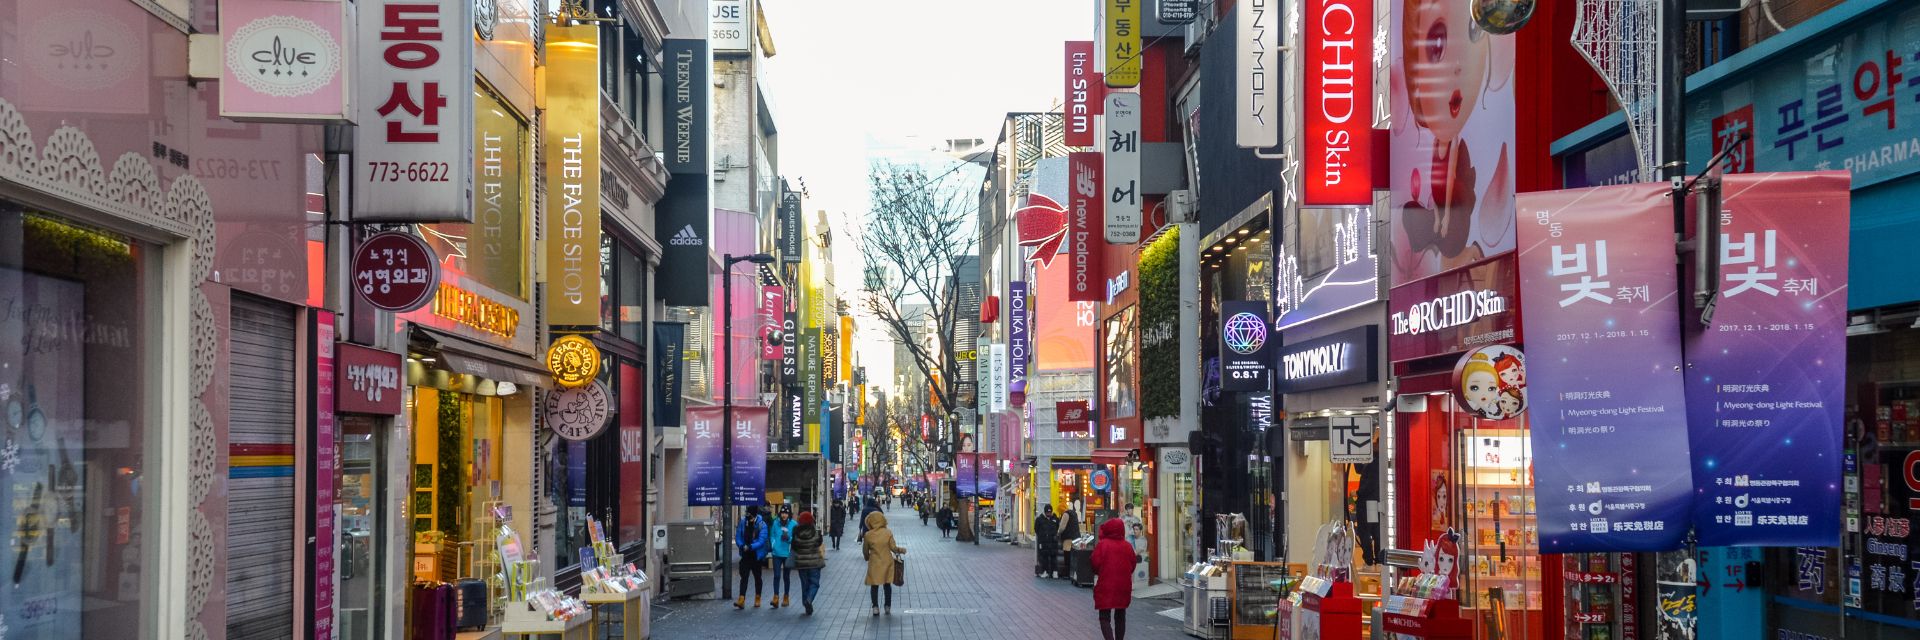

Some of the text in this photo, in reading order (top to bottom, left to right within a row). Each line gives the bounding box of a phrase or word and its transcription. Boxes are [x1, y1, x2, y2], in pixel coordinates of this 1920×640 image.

[677, 50, 692, 163] TEENIE WEENIE
[1073, 52, 1086, 132] the SAEM
[1322, 0, 1354, 187] CHID Skin
[368, 161, 449, 182] 773-6622
[563, 133, 581, 305] THE FACE SHOP
[370, 248, 408, 265] 노정식
[670, 235, 702, 246] adidas
[1076, 199, 1088, 292] new balance
[358, 268, 428, 294] 성형외과
[1551, 239, 1614, 309] 빛
[1720, 229, 1779, 298] 빛
[1616, 285, 1649, 303] 축제
[1783, 278, 1817, 296] 축제
[1077, 311, 1094, 326] HO
[1392, 289, 1504, 335] The ORCHID Skin
[783, 319, 795, 375] GUESS
[1012, 289, 1023, 383] HOLIKA HOLIKA
[551, 341, 592, 375] THE FACE SHOP
[1283, 342, 1346, 380] TONYMOLY
[980, 359, 988, 407] MISSHA
[793, 394, 801, 438] ARITAUM
[1568, 404, 1665, 417] Myeong-dong Light Festival
[1723, 401, 1822, 411] Myeong-dong Light Festival
[621, 430, 641, 463] SALE
[1867, 538, 1907, 561] Ginseng
